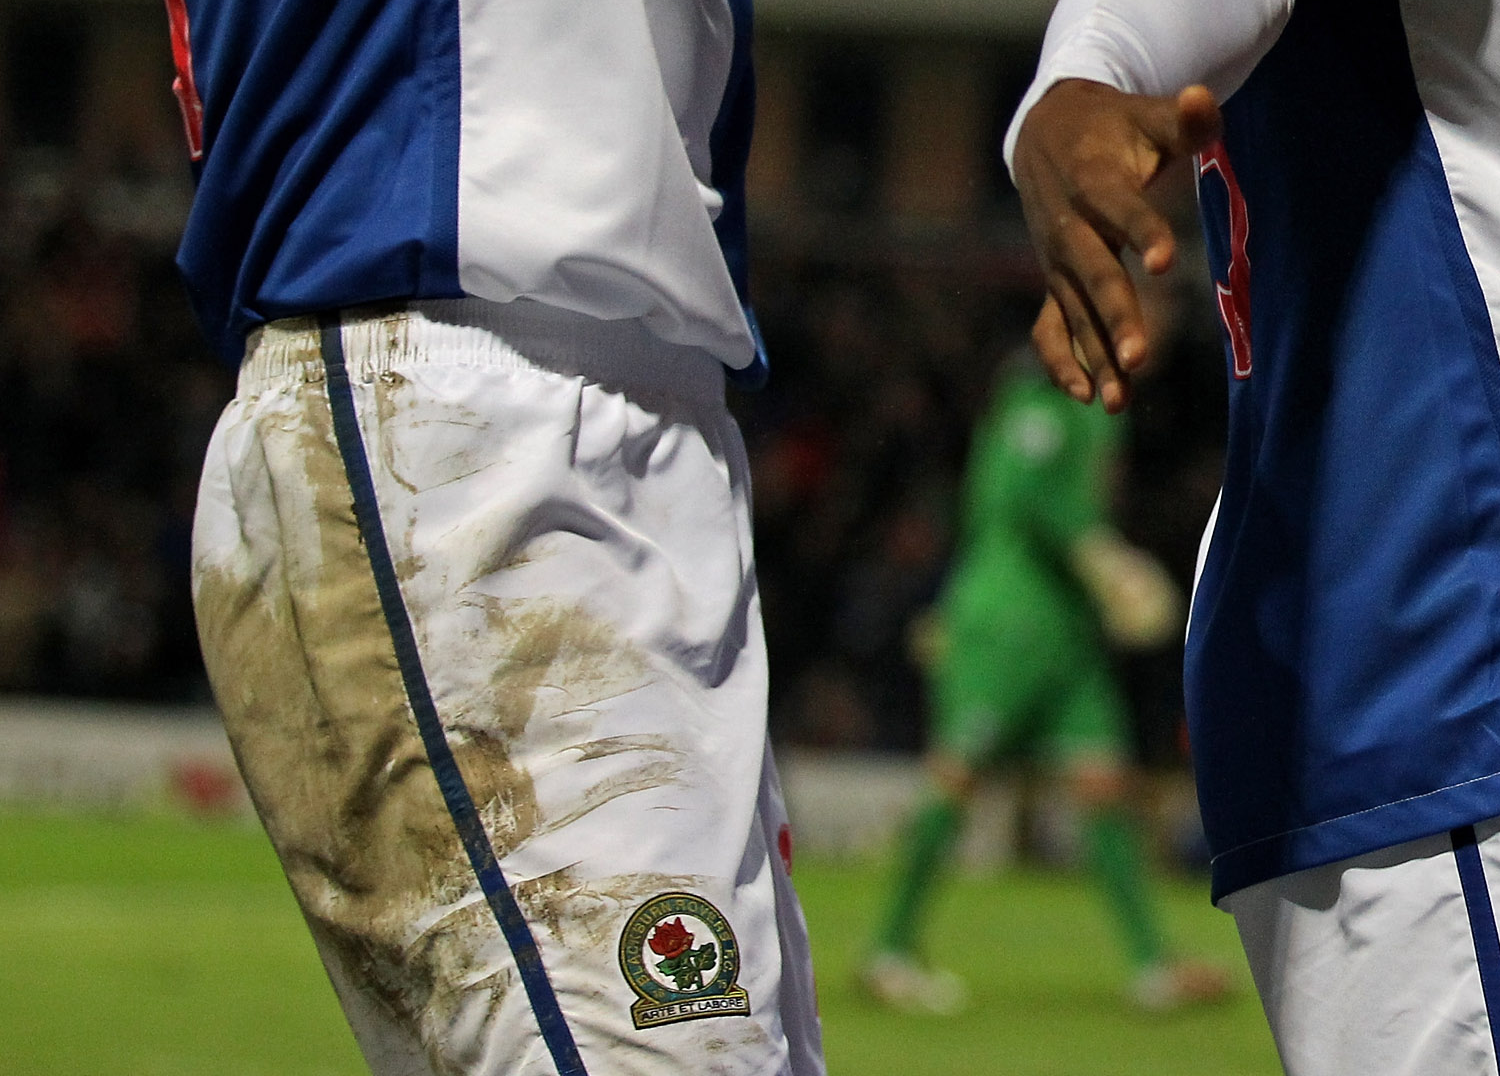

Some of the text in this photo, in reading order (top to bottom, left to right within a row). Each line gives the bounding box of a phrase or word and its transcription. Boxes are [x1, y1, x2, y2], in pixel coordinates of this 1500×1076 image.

[626, 900, 673, 987] BLACKBURN
[674, 899, 732, 942] ROVERS
[641, 997, 745, 1022] ARTE ET LABORE
